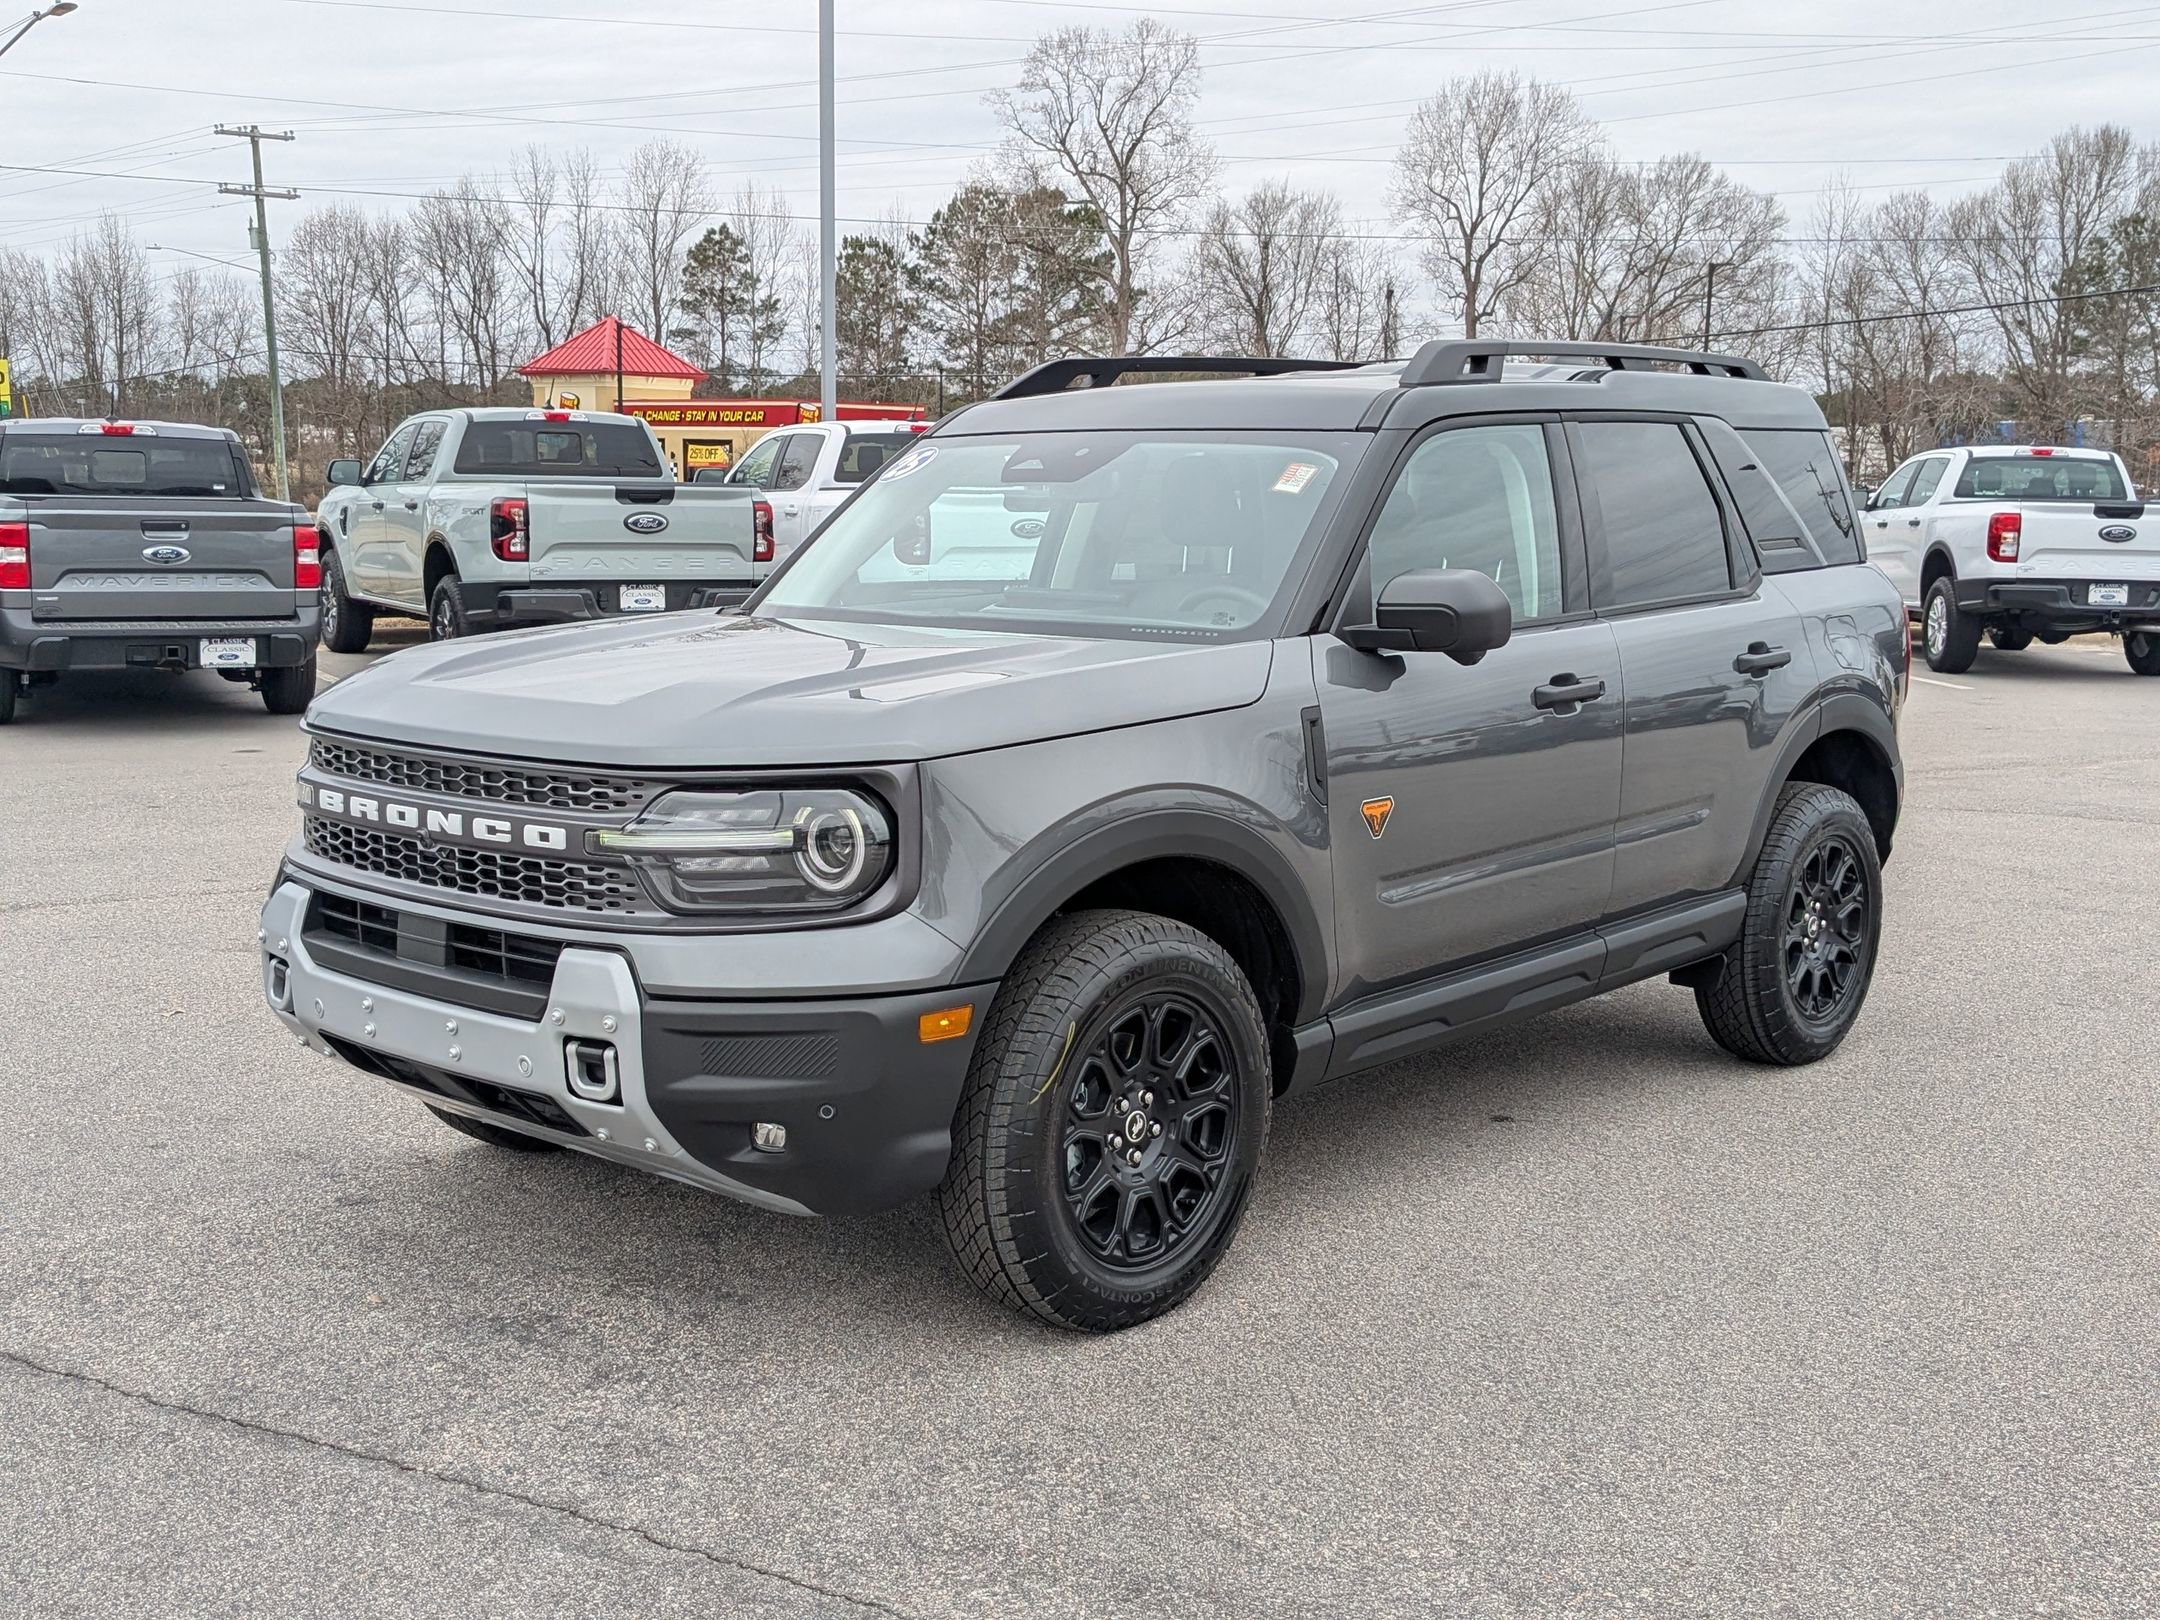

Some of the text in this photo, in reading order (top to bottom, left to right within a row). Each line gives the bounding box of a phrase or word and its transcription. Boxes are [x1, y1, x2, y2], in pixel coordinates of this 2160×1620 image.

[646, 410, 680, 421] CHANGE
[686, 411, 706, 421] STAY
[708, 411, 718, 421] IN
[720, 411, 747, 422] YOUR
[745, 411, 764, 422] CAR
[800, 408, 815, 418] TAKE
[690, 448, 719, 459] 25% OFF
[637, 517, 659, 528] Ford
[552, 557, 737, 569] RANGER
[71, 576, 260, 588] MAVERICK
[319, 788, 567, 850] BRONCO
